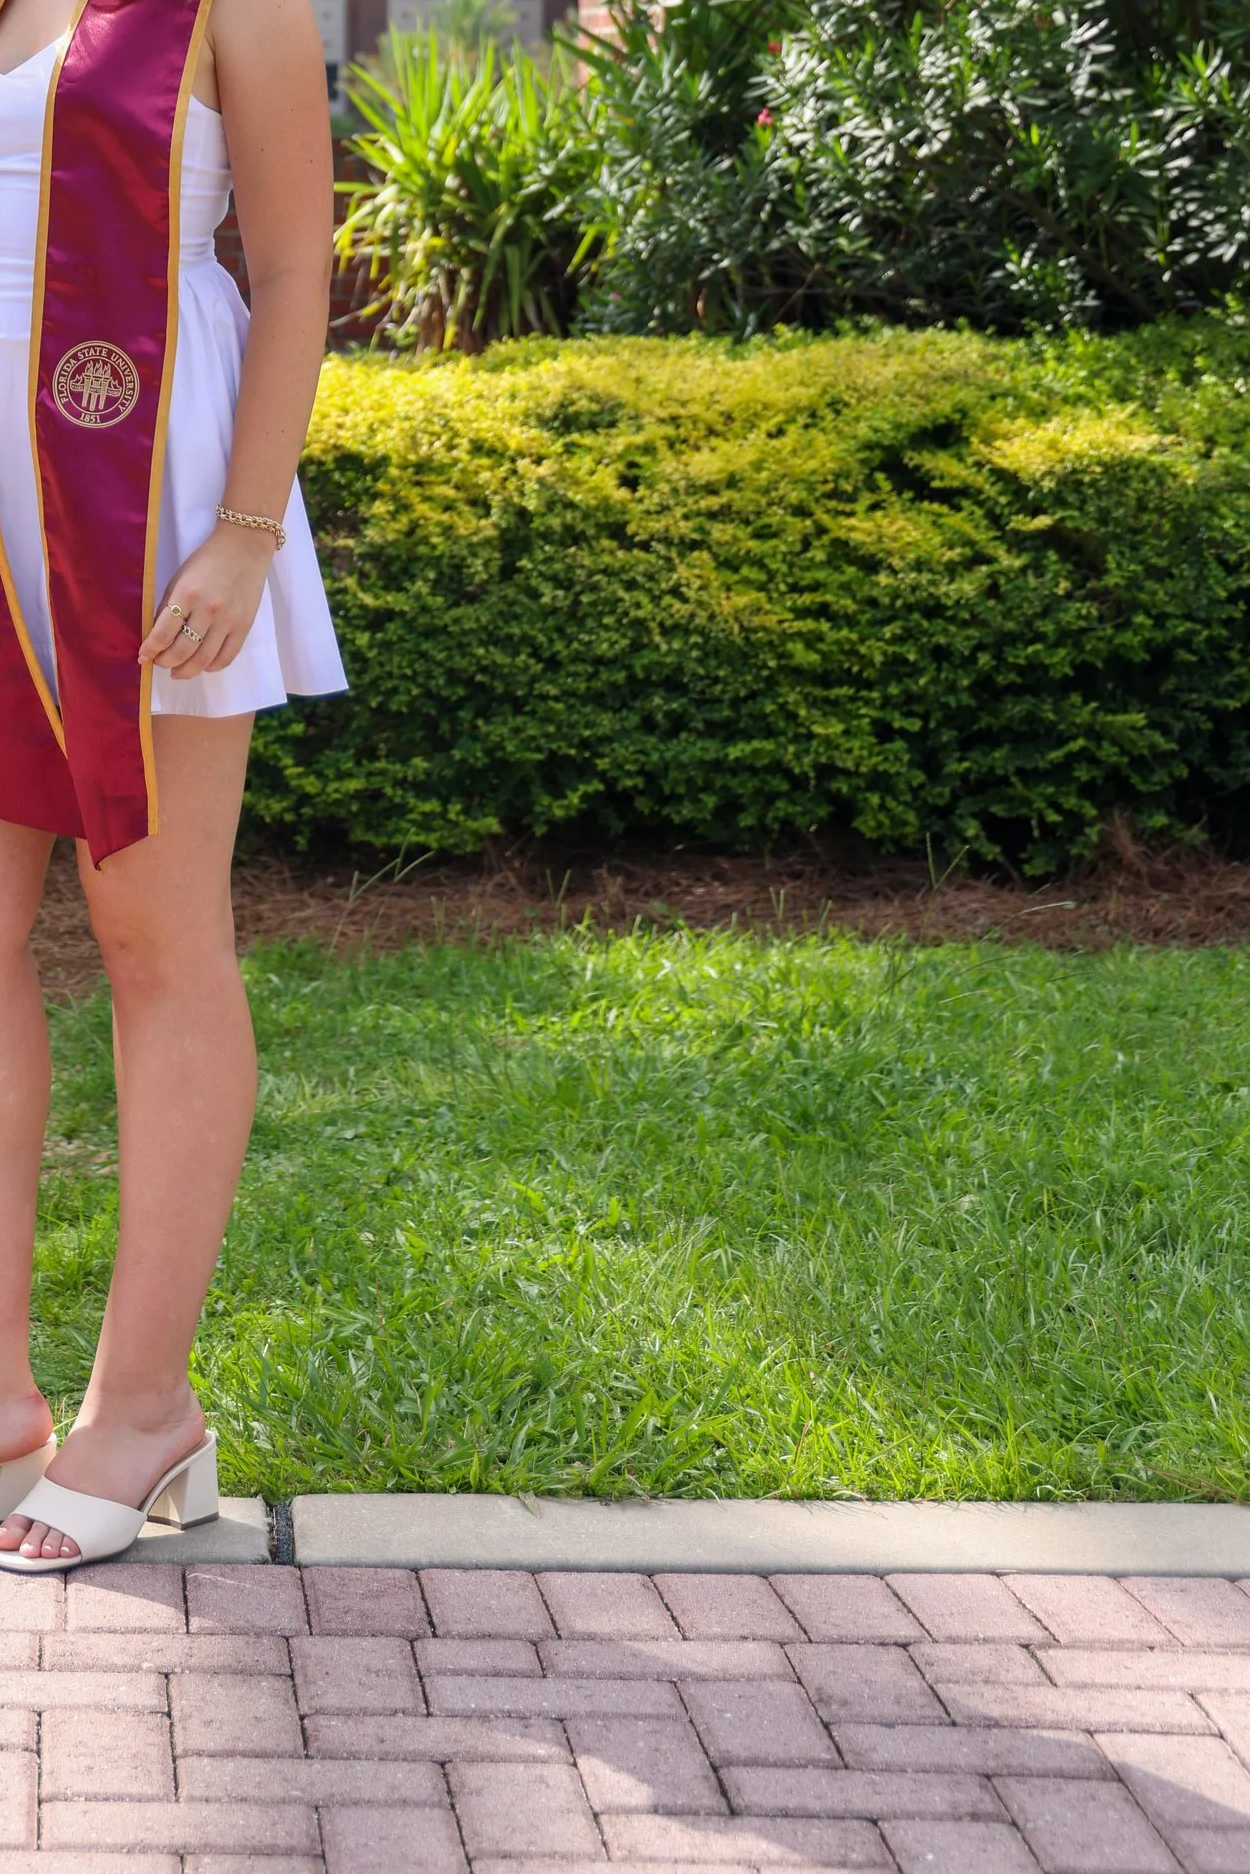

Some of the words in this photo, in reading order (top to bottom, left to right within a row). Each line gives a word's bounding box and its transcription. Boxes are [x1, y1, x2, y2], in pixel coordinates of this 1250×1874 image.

[58, 358, 78, 404] FLORIDA
[77, 347, 109, 360] STATE
[110, 352, 134, 413] UNIVERSITY
[79, 413, 101, 423] 1851
